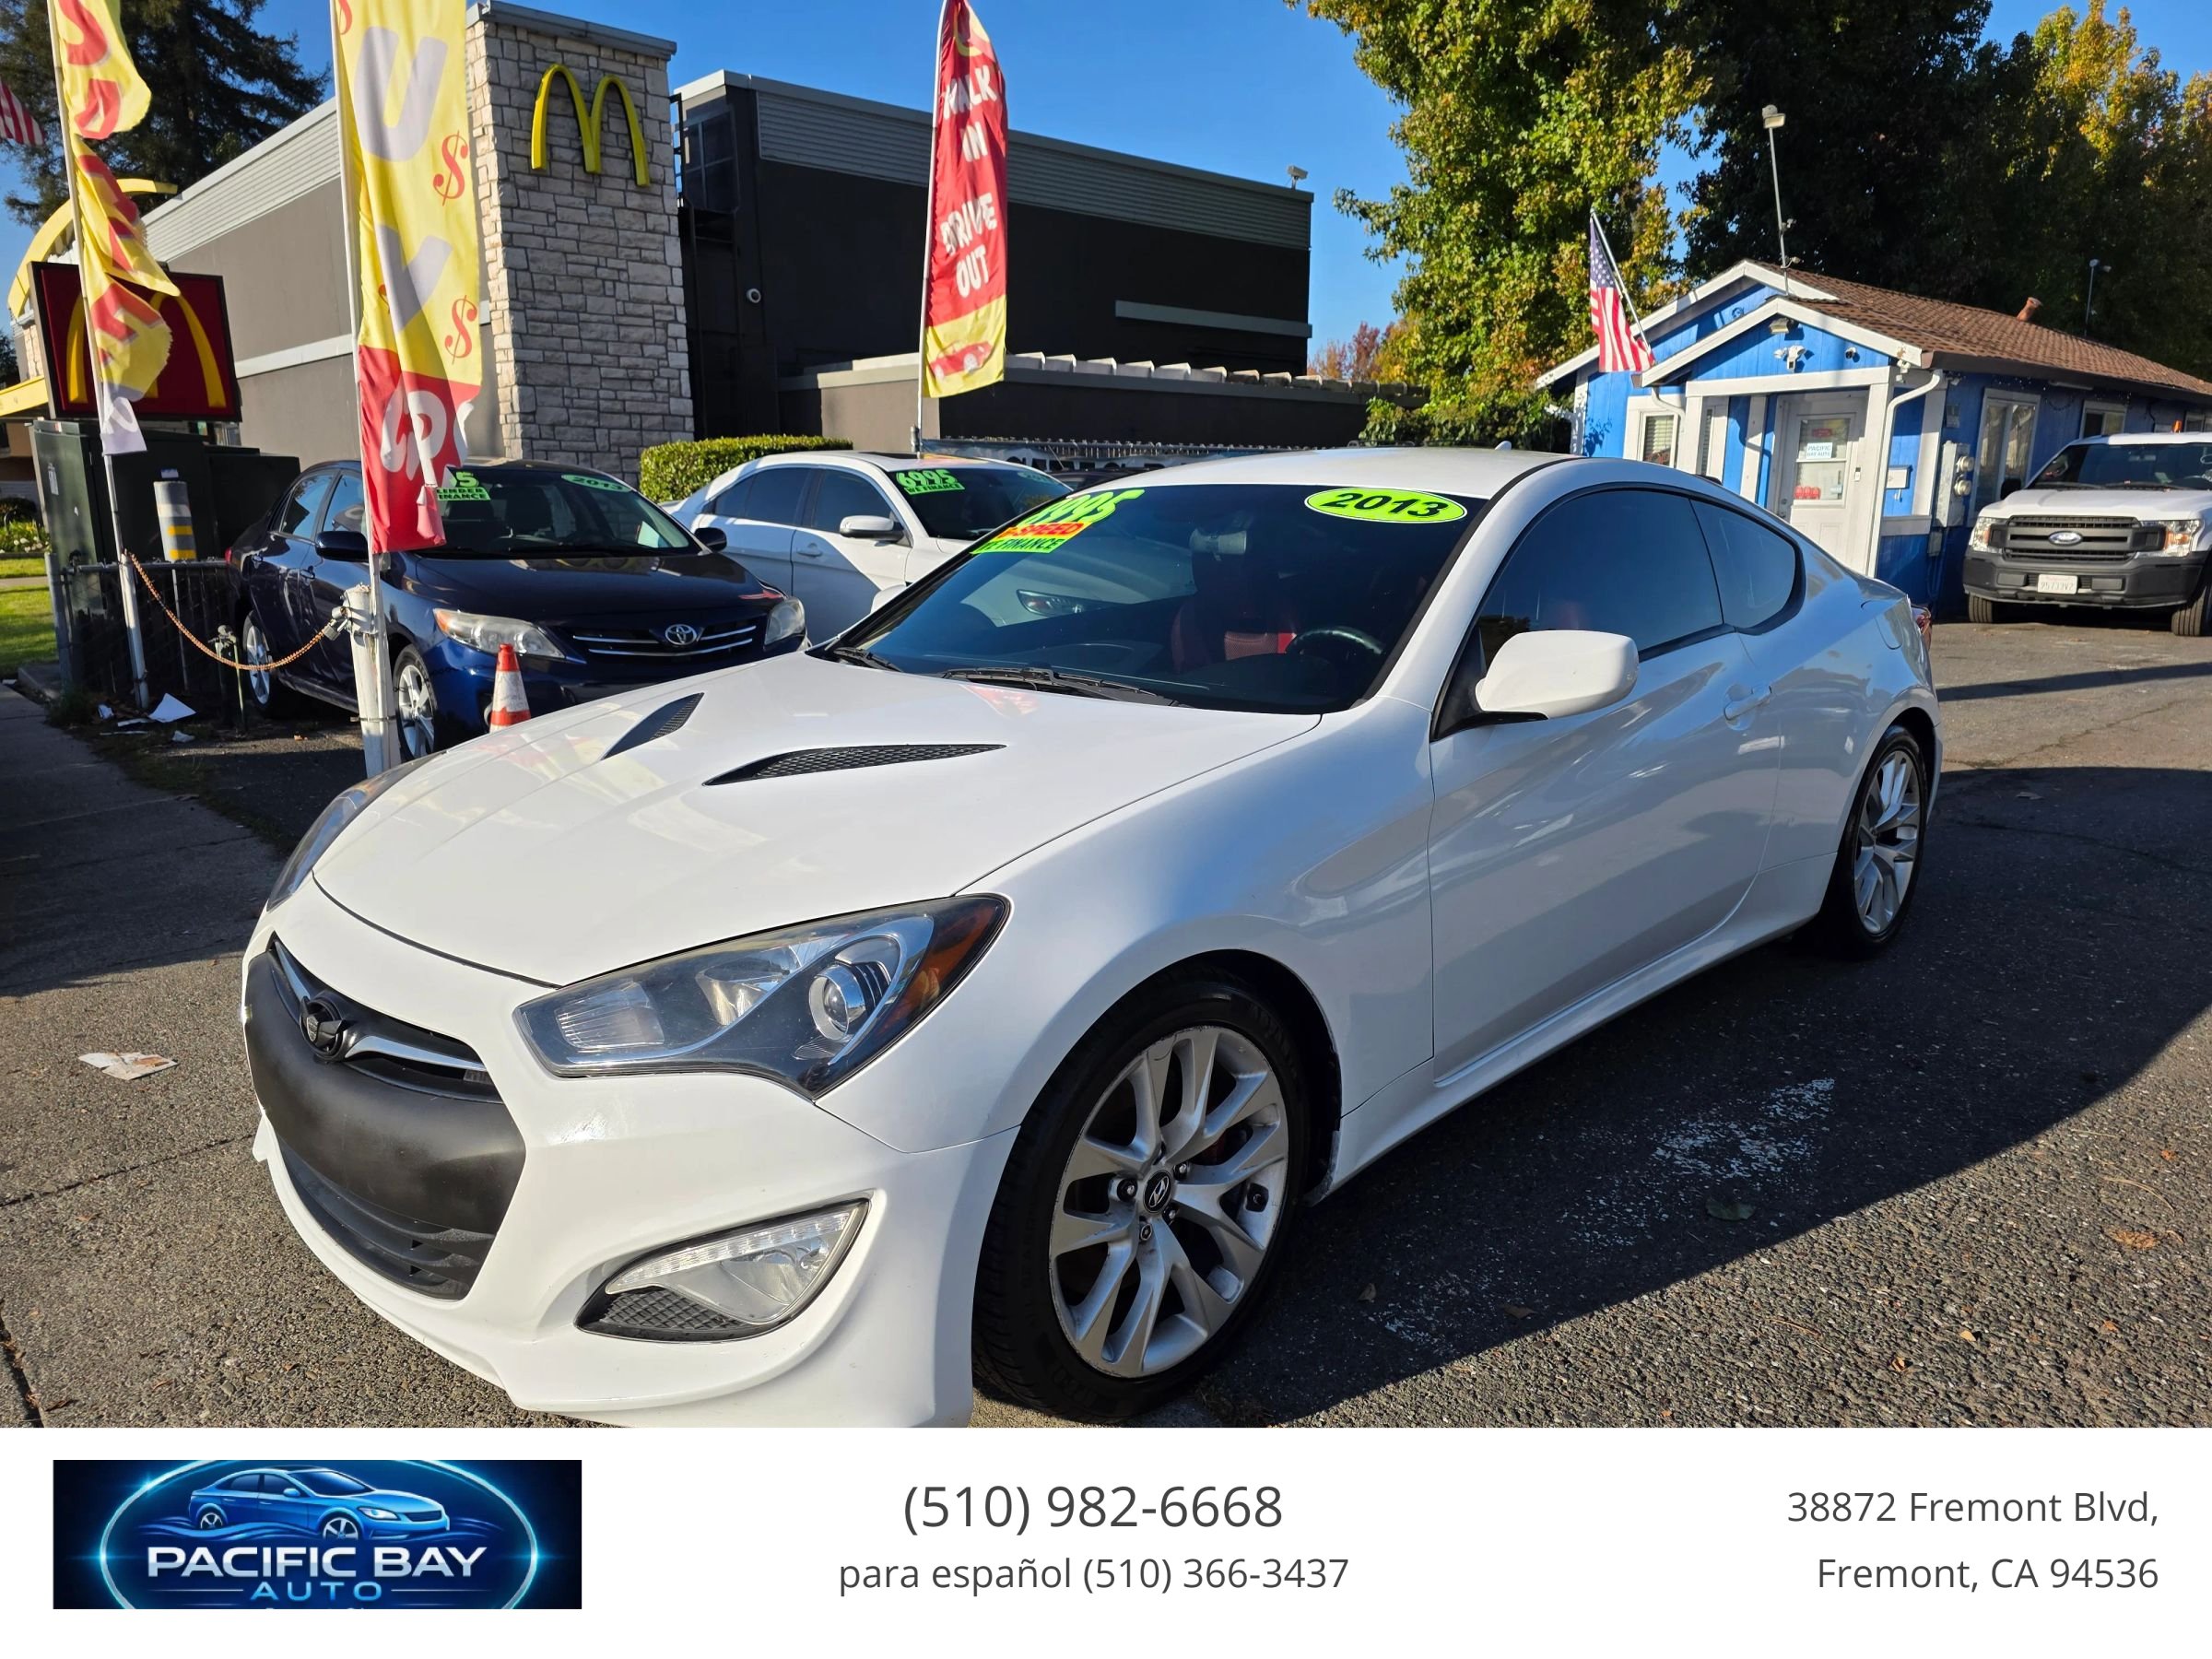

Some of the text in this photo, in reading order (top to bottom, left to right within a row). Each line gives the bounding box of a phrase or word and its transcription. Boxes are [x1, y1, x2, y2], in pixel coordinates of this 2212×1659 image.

[943, 65, 996, 120] WALK
[531, 64, 650, 187] M
[960, 122, 988, 162] IN
[940, 193, 996, 255] DRIVE
[956, 244, 989, 298] OUT
[897, 469, 958, 488] 6995
[923, 483, 960, 491] FINANCE
[1320, 492, 1450, 517] 2013
[997, 537, 1065, 550] FINANCE
